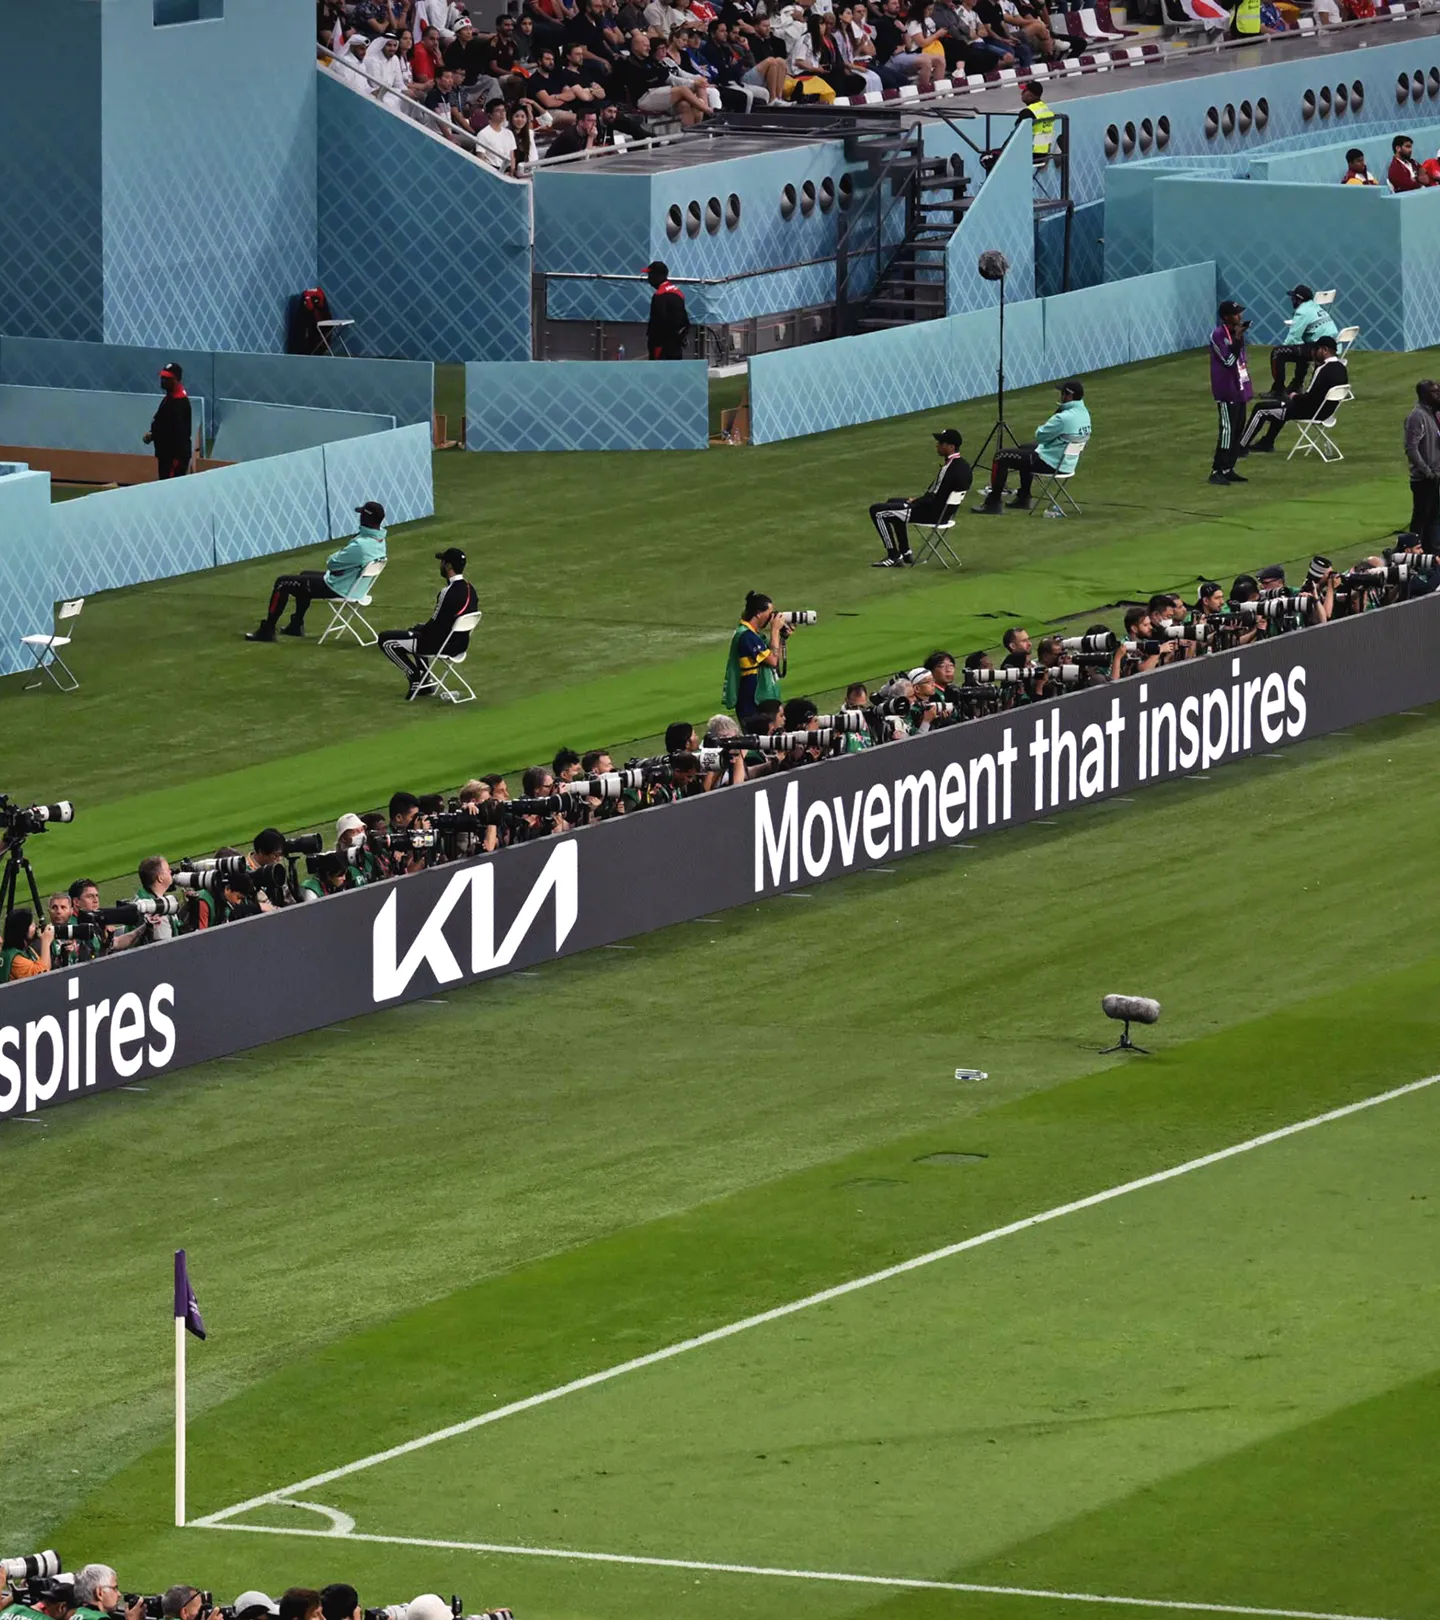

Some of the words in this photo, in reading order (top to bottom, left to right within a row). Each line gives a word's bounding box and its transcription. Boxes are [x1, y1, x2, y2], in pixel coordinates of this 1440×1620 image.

[755, 728, 1018, 893] Movement
[1029, 697, 1126, 811] that
[1138, 658, 1307, 781] inspires
